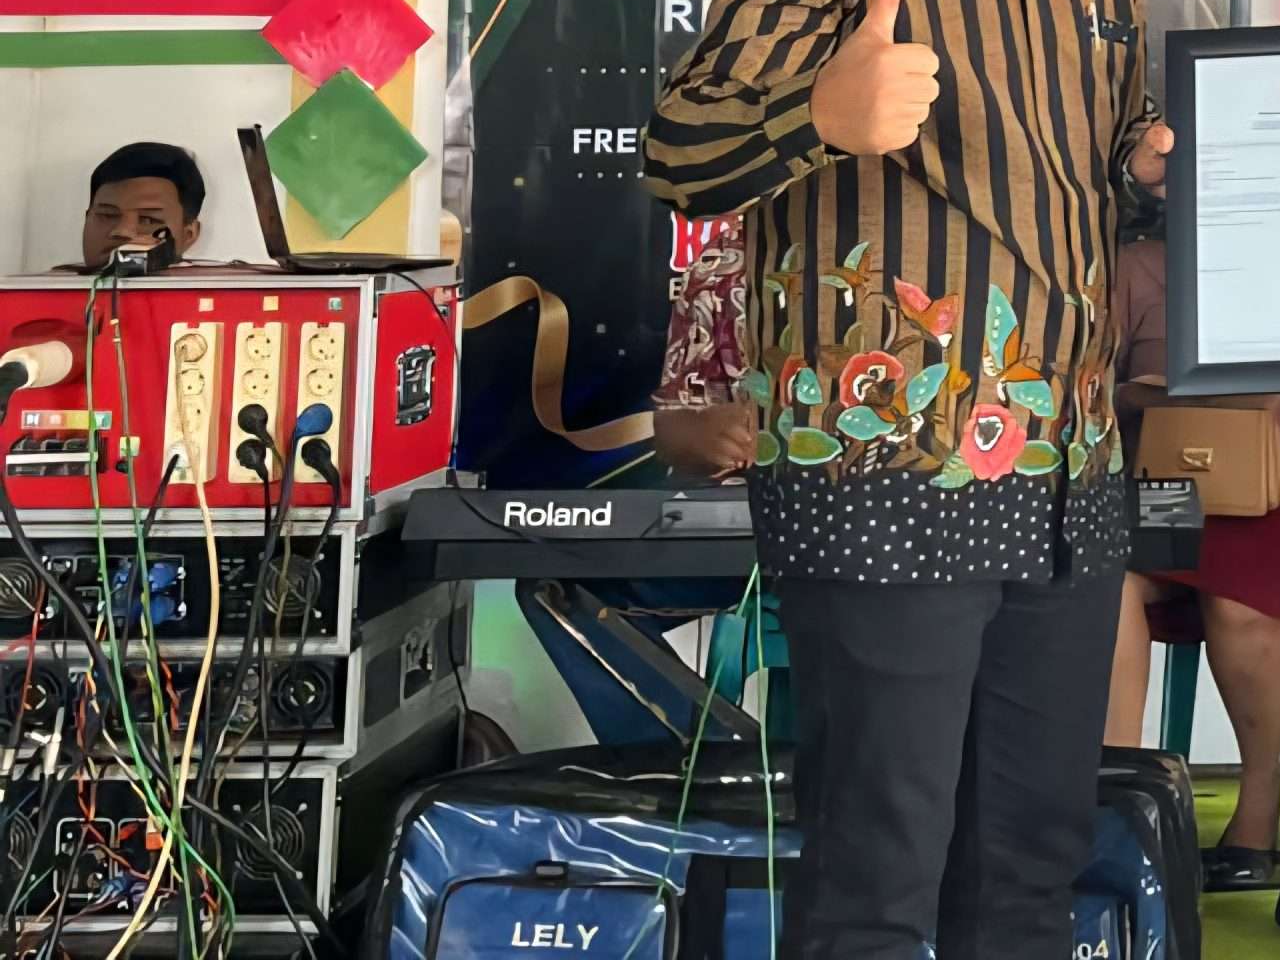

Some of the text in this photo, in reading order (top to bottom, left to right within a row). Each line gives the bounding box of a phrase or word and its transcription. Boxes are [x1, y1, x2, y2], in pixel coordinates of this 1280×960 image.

[572, 127, 638, 155] FRE
[503, 501, 613, 529] Roland
[511, 921, 599, 951] LELY
